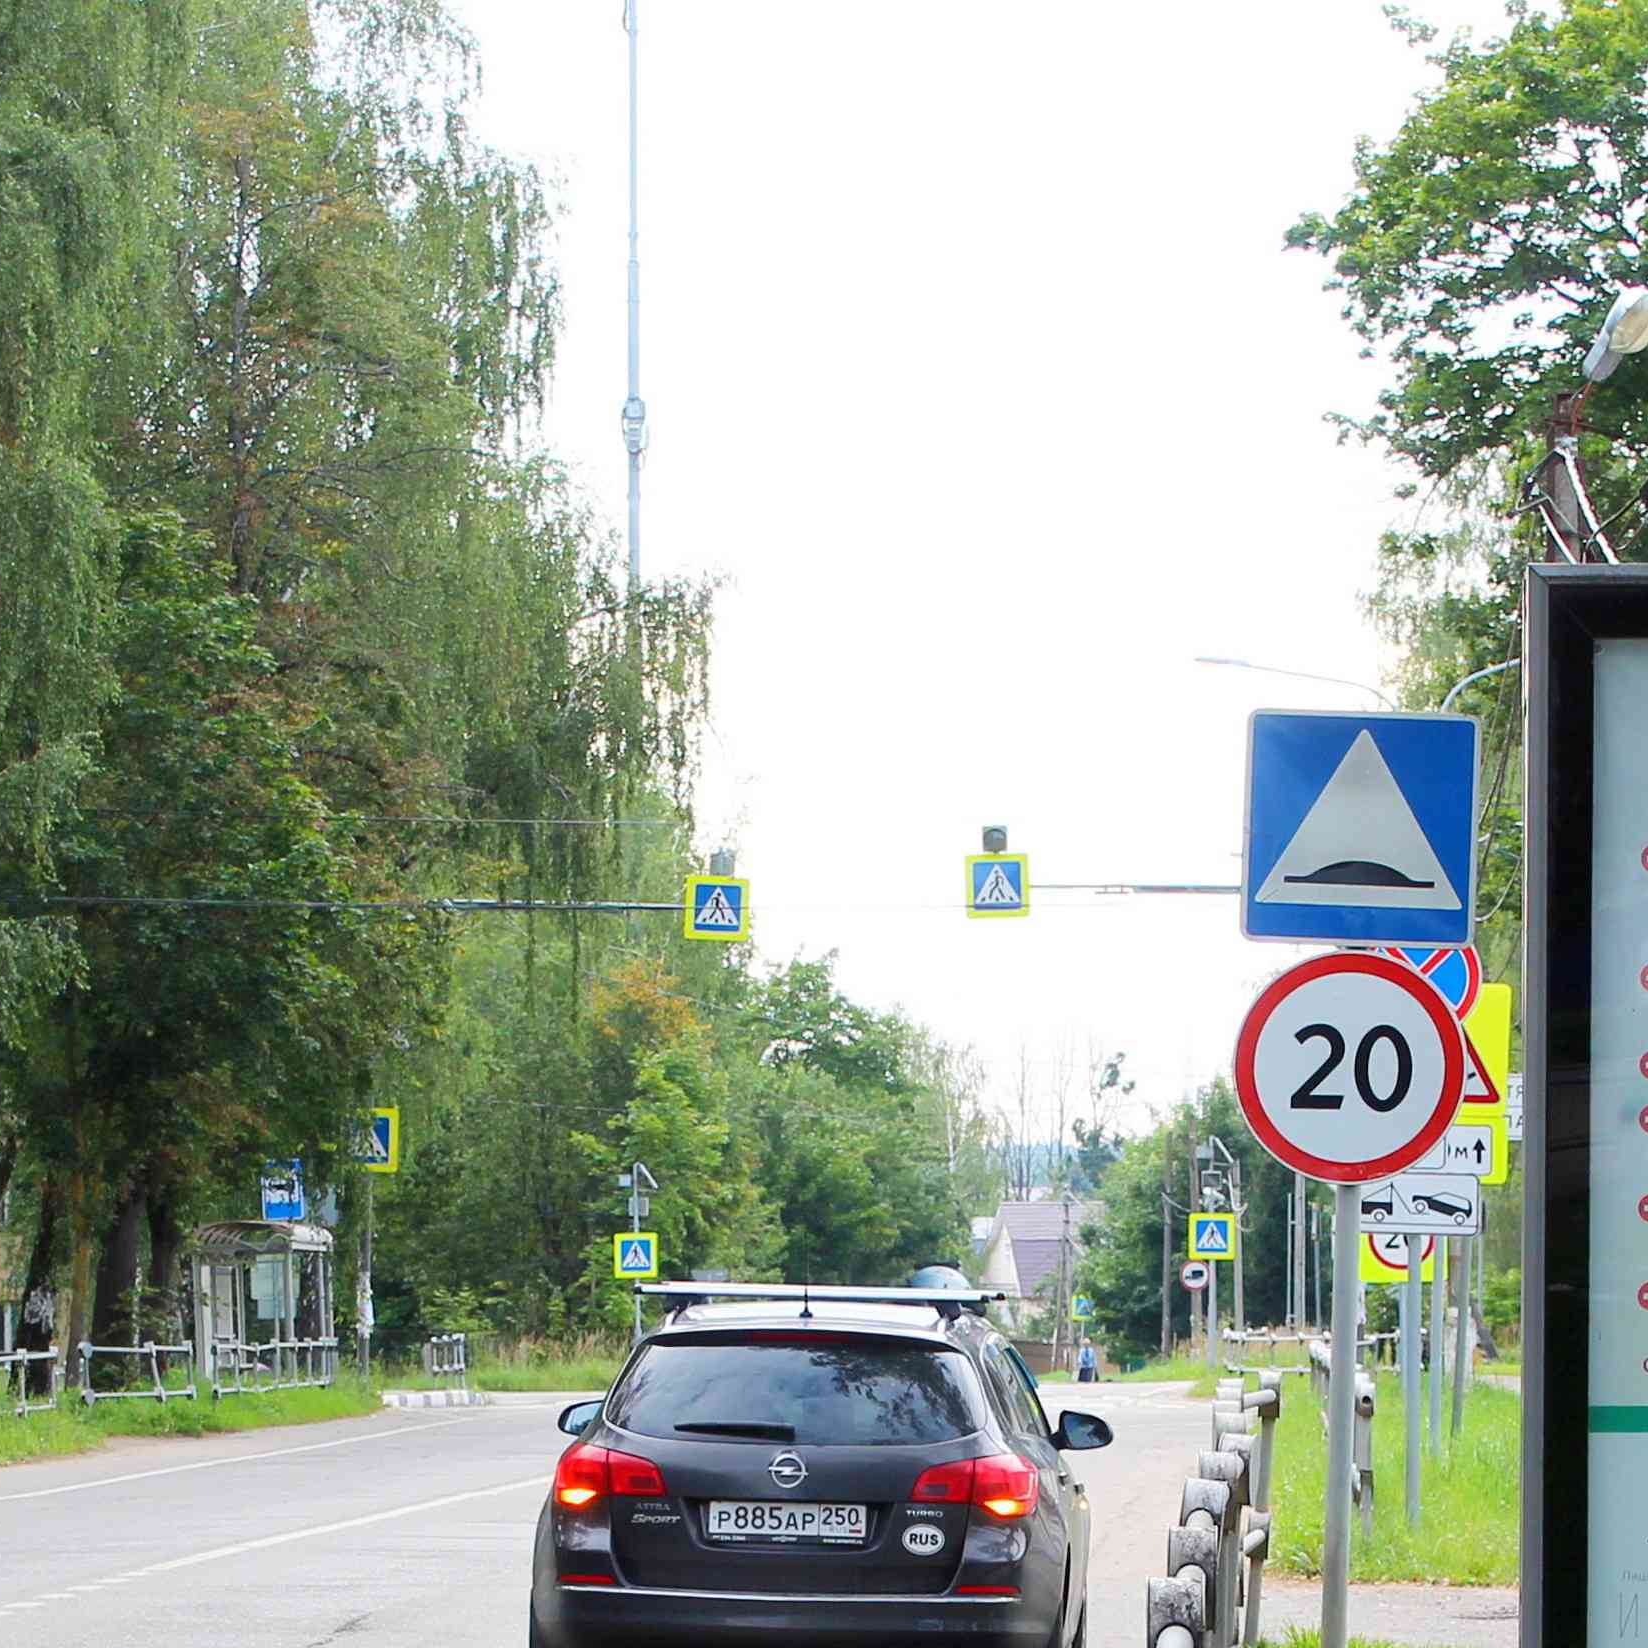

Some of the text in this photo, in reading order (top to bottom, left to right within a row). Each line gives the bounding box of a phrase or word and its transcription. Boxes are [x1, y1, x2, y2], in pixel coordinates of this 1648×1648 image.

[1289, 1023, 1413, 1112] 20
[821, 1507, 860, 1526] 250
[909, 1533, 939, 1546] RUS
